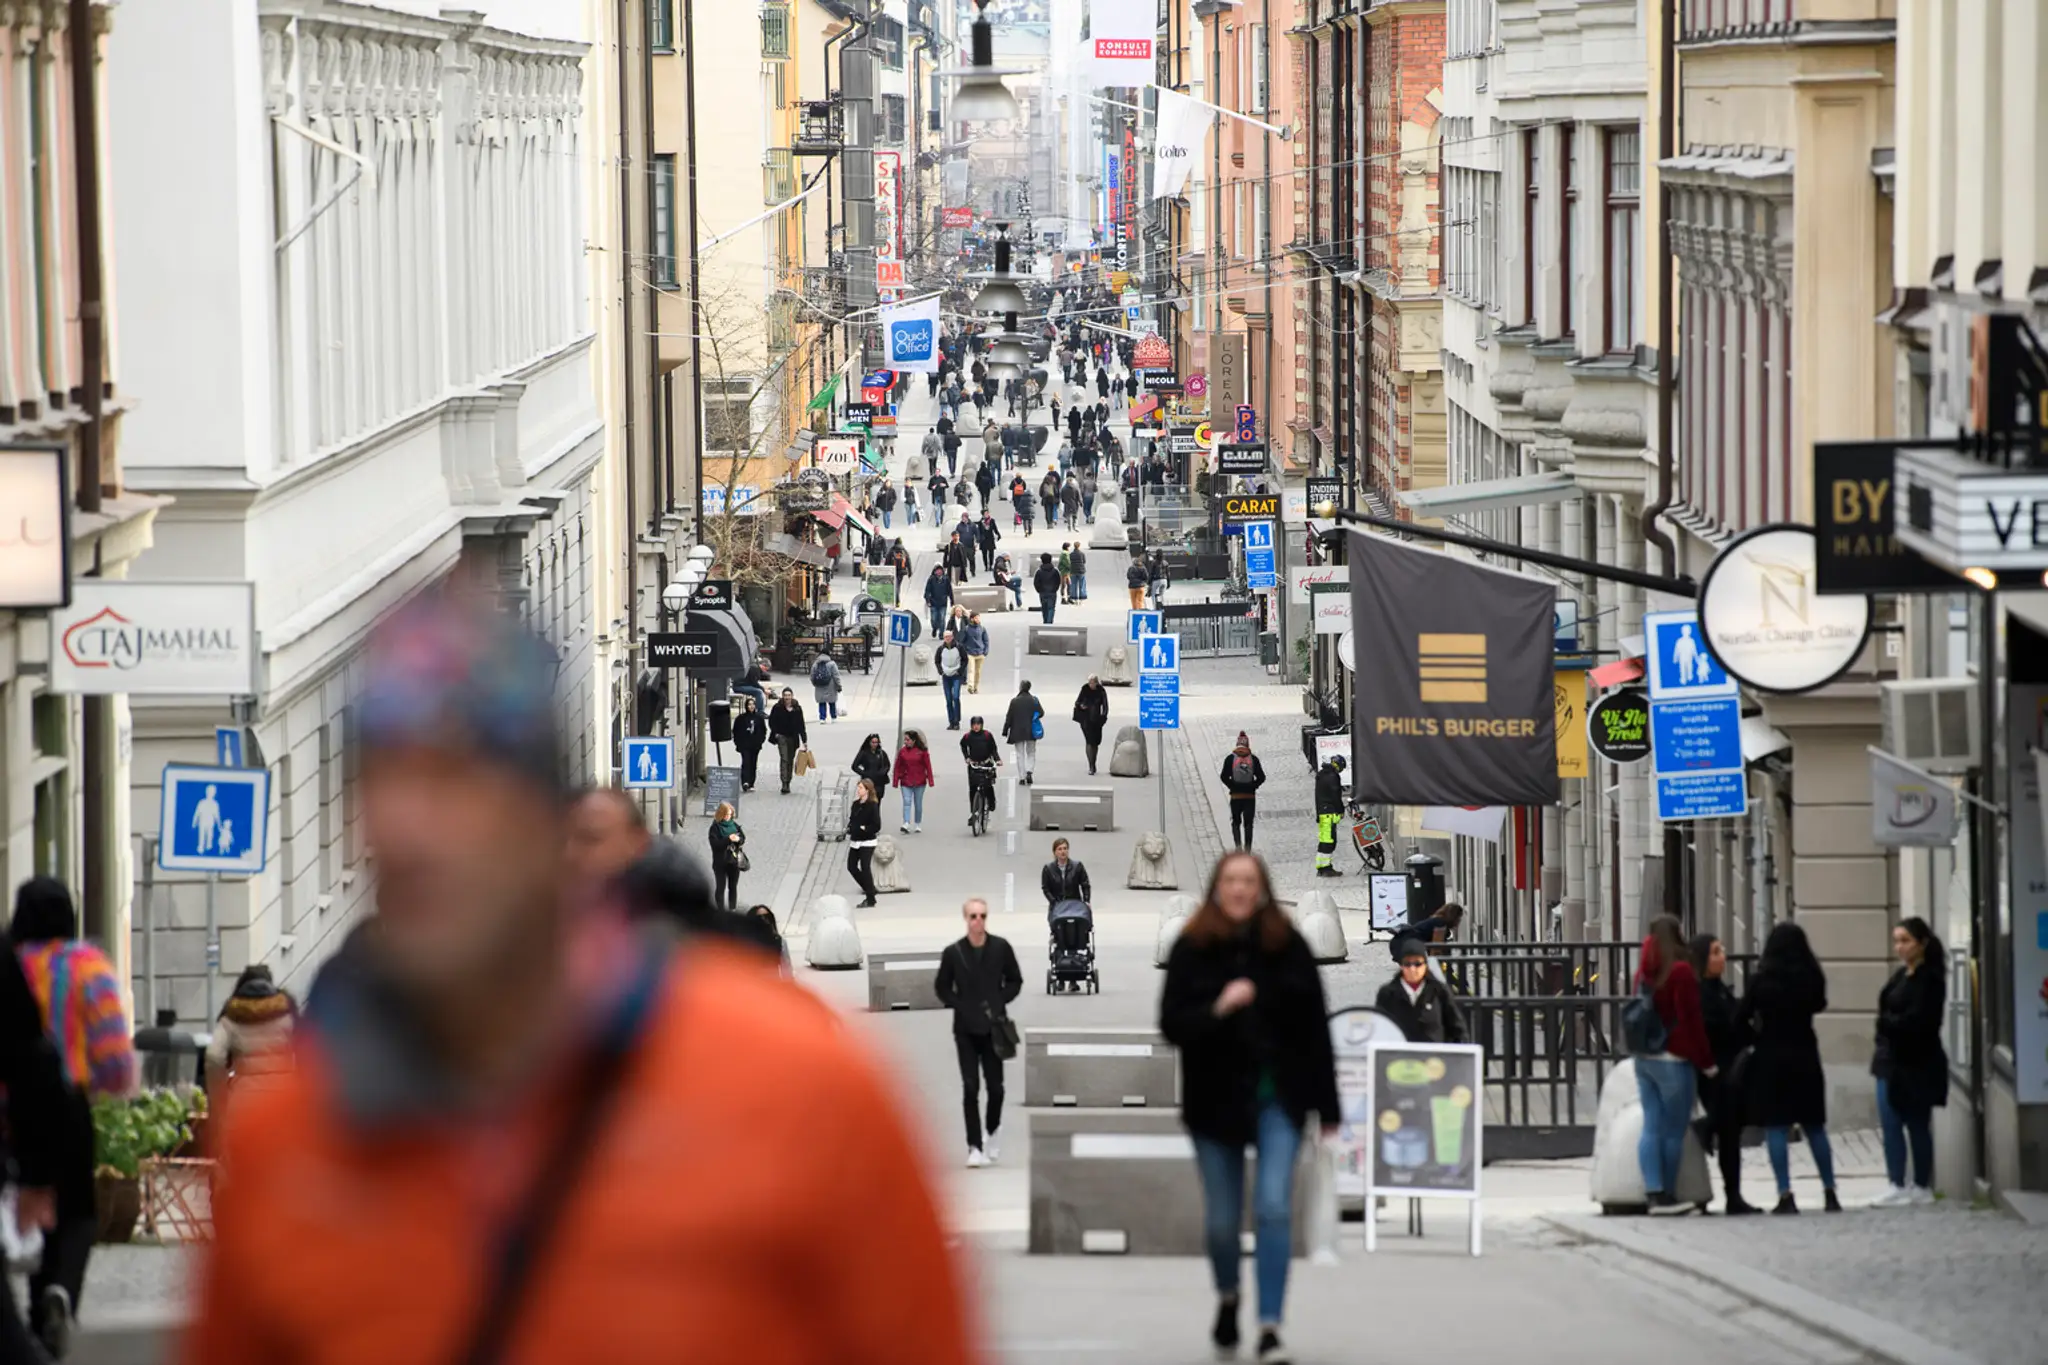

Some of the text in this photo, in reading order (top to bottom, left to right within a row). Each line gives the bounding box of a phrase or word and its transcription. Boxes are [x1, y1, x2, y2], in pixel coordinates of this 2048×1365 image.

[1124, 129, 1136, 240] APOTEK
[895, 328, 929, 344] Quick
[896, 341, 930, 355] Office
[1310, 485, 1340, 493] INDIAN
[1310, 493, 1340, 501] STREET
[1226, 499, 1277, 514] CARAT
[1832, 479, 1890, 524] BY
[694, 596, 727, 606] Synoptik
[78, 627, 239, 670] TAJ MAHAL
[654, 645, 712, 655] WHYRED
[1601, 709, 1621, 727] Vi
[1376, 717, 1536, 737] PHIL'S BURGER
[1607, 726, 1643, 742] Fresh
